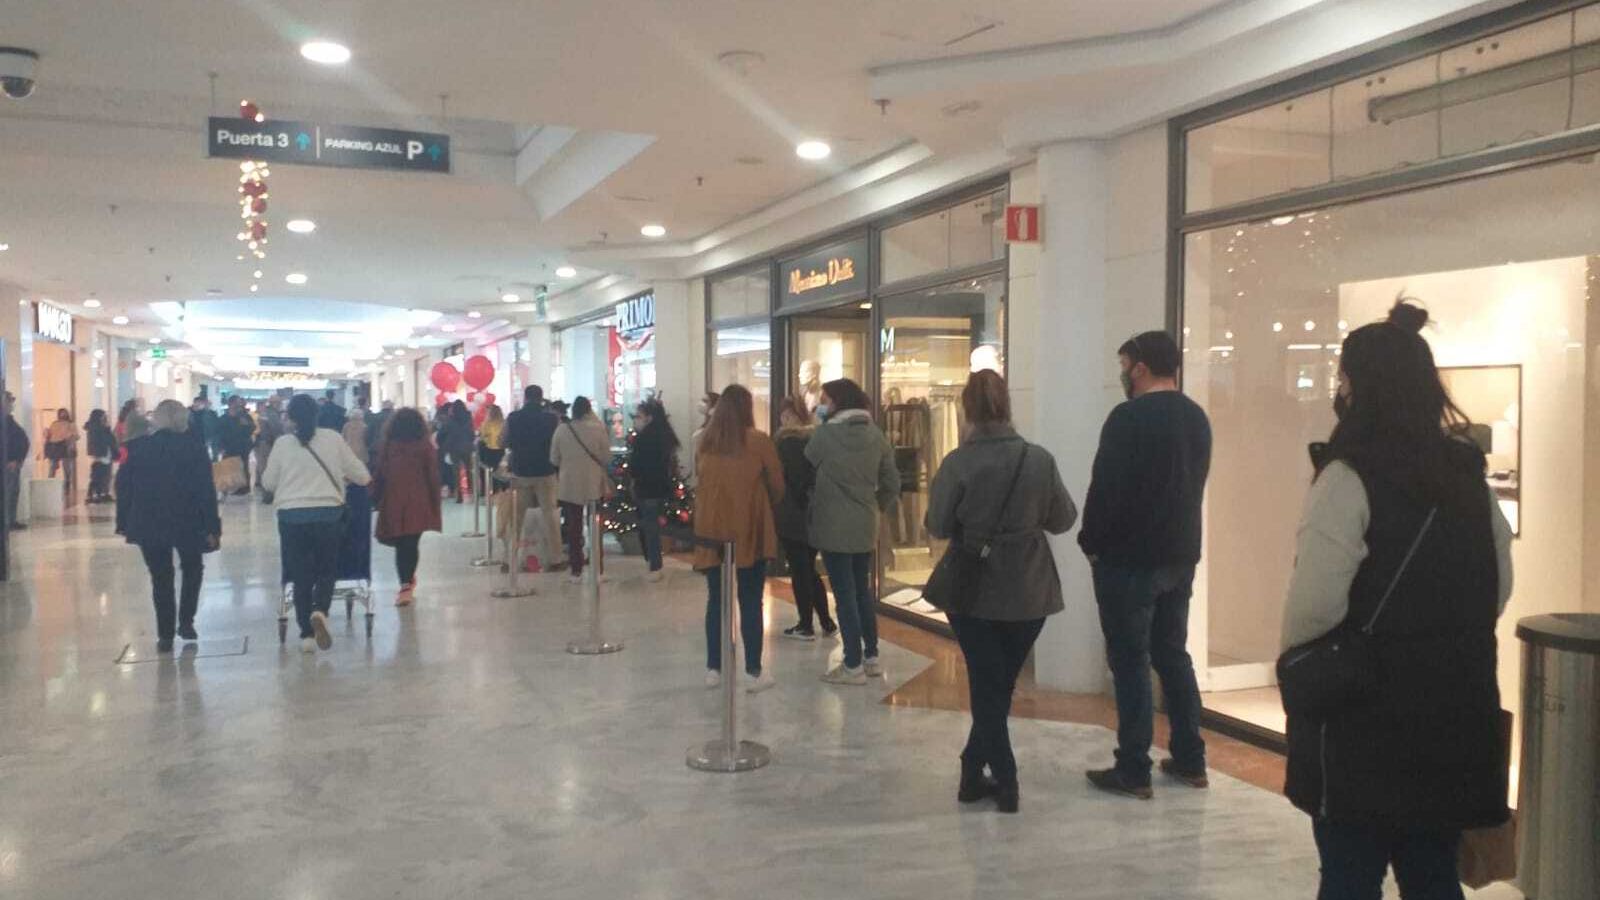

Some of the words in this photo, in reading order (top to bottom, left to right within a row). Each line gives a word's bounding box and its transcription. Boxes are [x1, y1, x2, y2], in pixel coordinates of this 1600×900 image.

[217, 130, 273, 147] Puerta
[277, 132, 289, 148] 3
[324, 138, 373, 151] PARKING
[375, 142, 402, 154] AZUL
[407, 140, 424, 160] P
